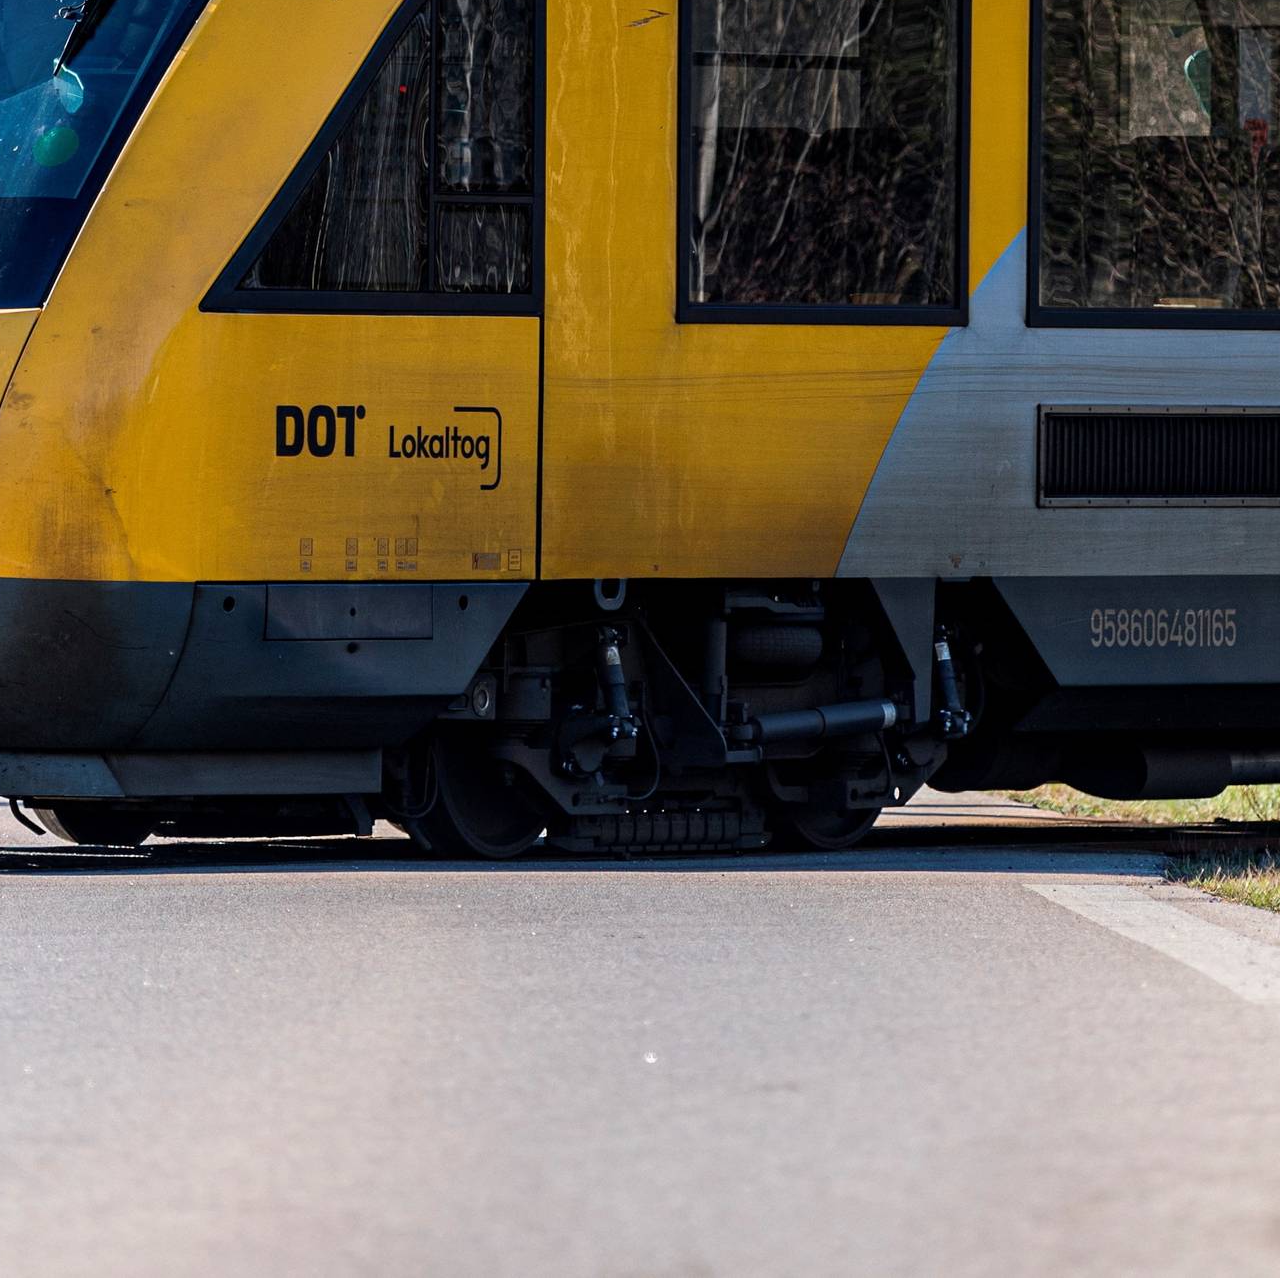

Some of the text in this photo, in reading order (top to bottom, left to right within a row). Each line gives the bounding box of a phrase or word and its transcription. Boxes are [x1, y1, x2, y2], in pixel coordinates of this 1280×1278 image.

[276, 405, 360, 457] DOT
[389, 425, 490, 470] Lokaltog
[1090, 608, 1237, 648] 958606481165
